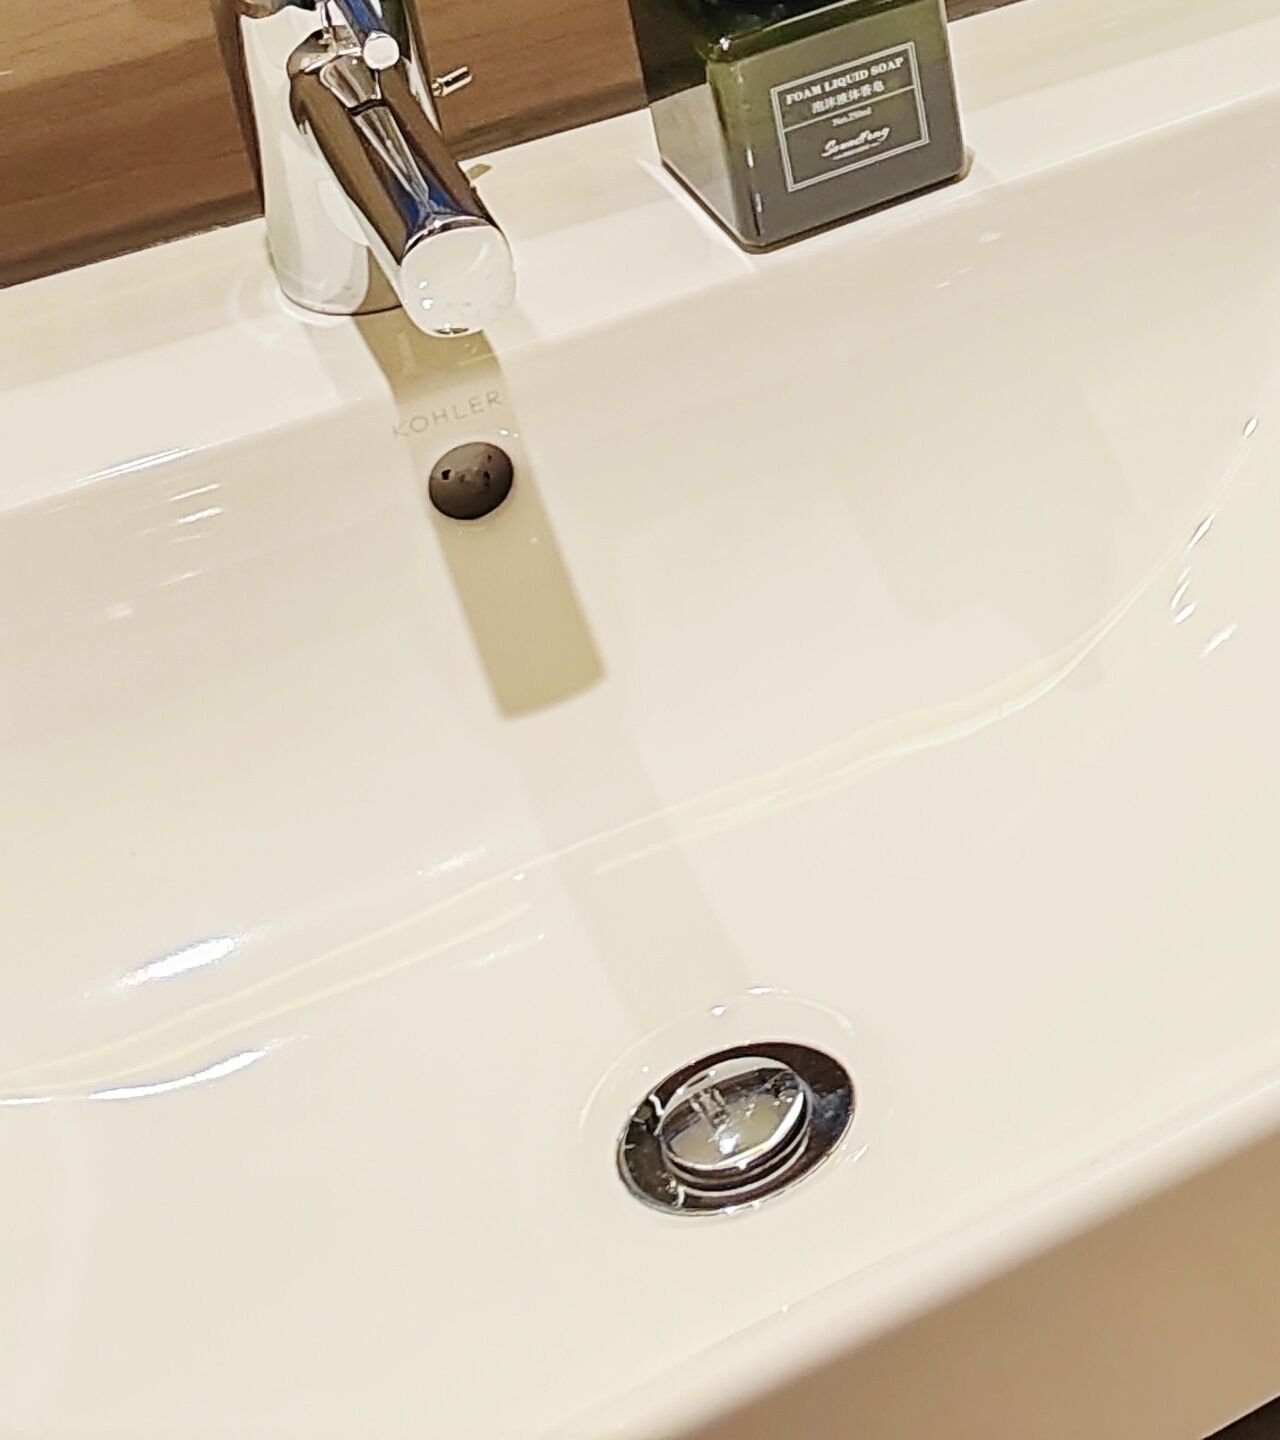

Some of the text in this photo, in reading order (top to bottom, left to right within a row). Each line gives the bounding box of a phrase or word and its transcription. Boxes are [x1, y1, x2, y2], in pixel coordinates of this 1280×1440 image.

[785, 57, 904, 106] FOAM LIQUID SOAP
[392, 390, 503, 439] KOHLER
